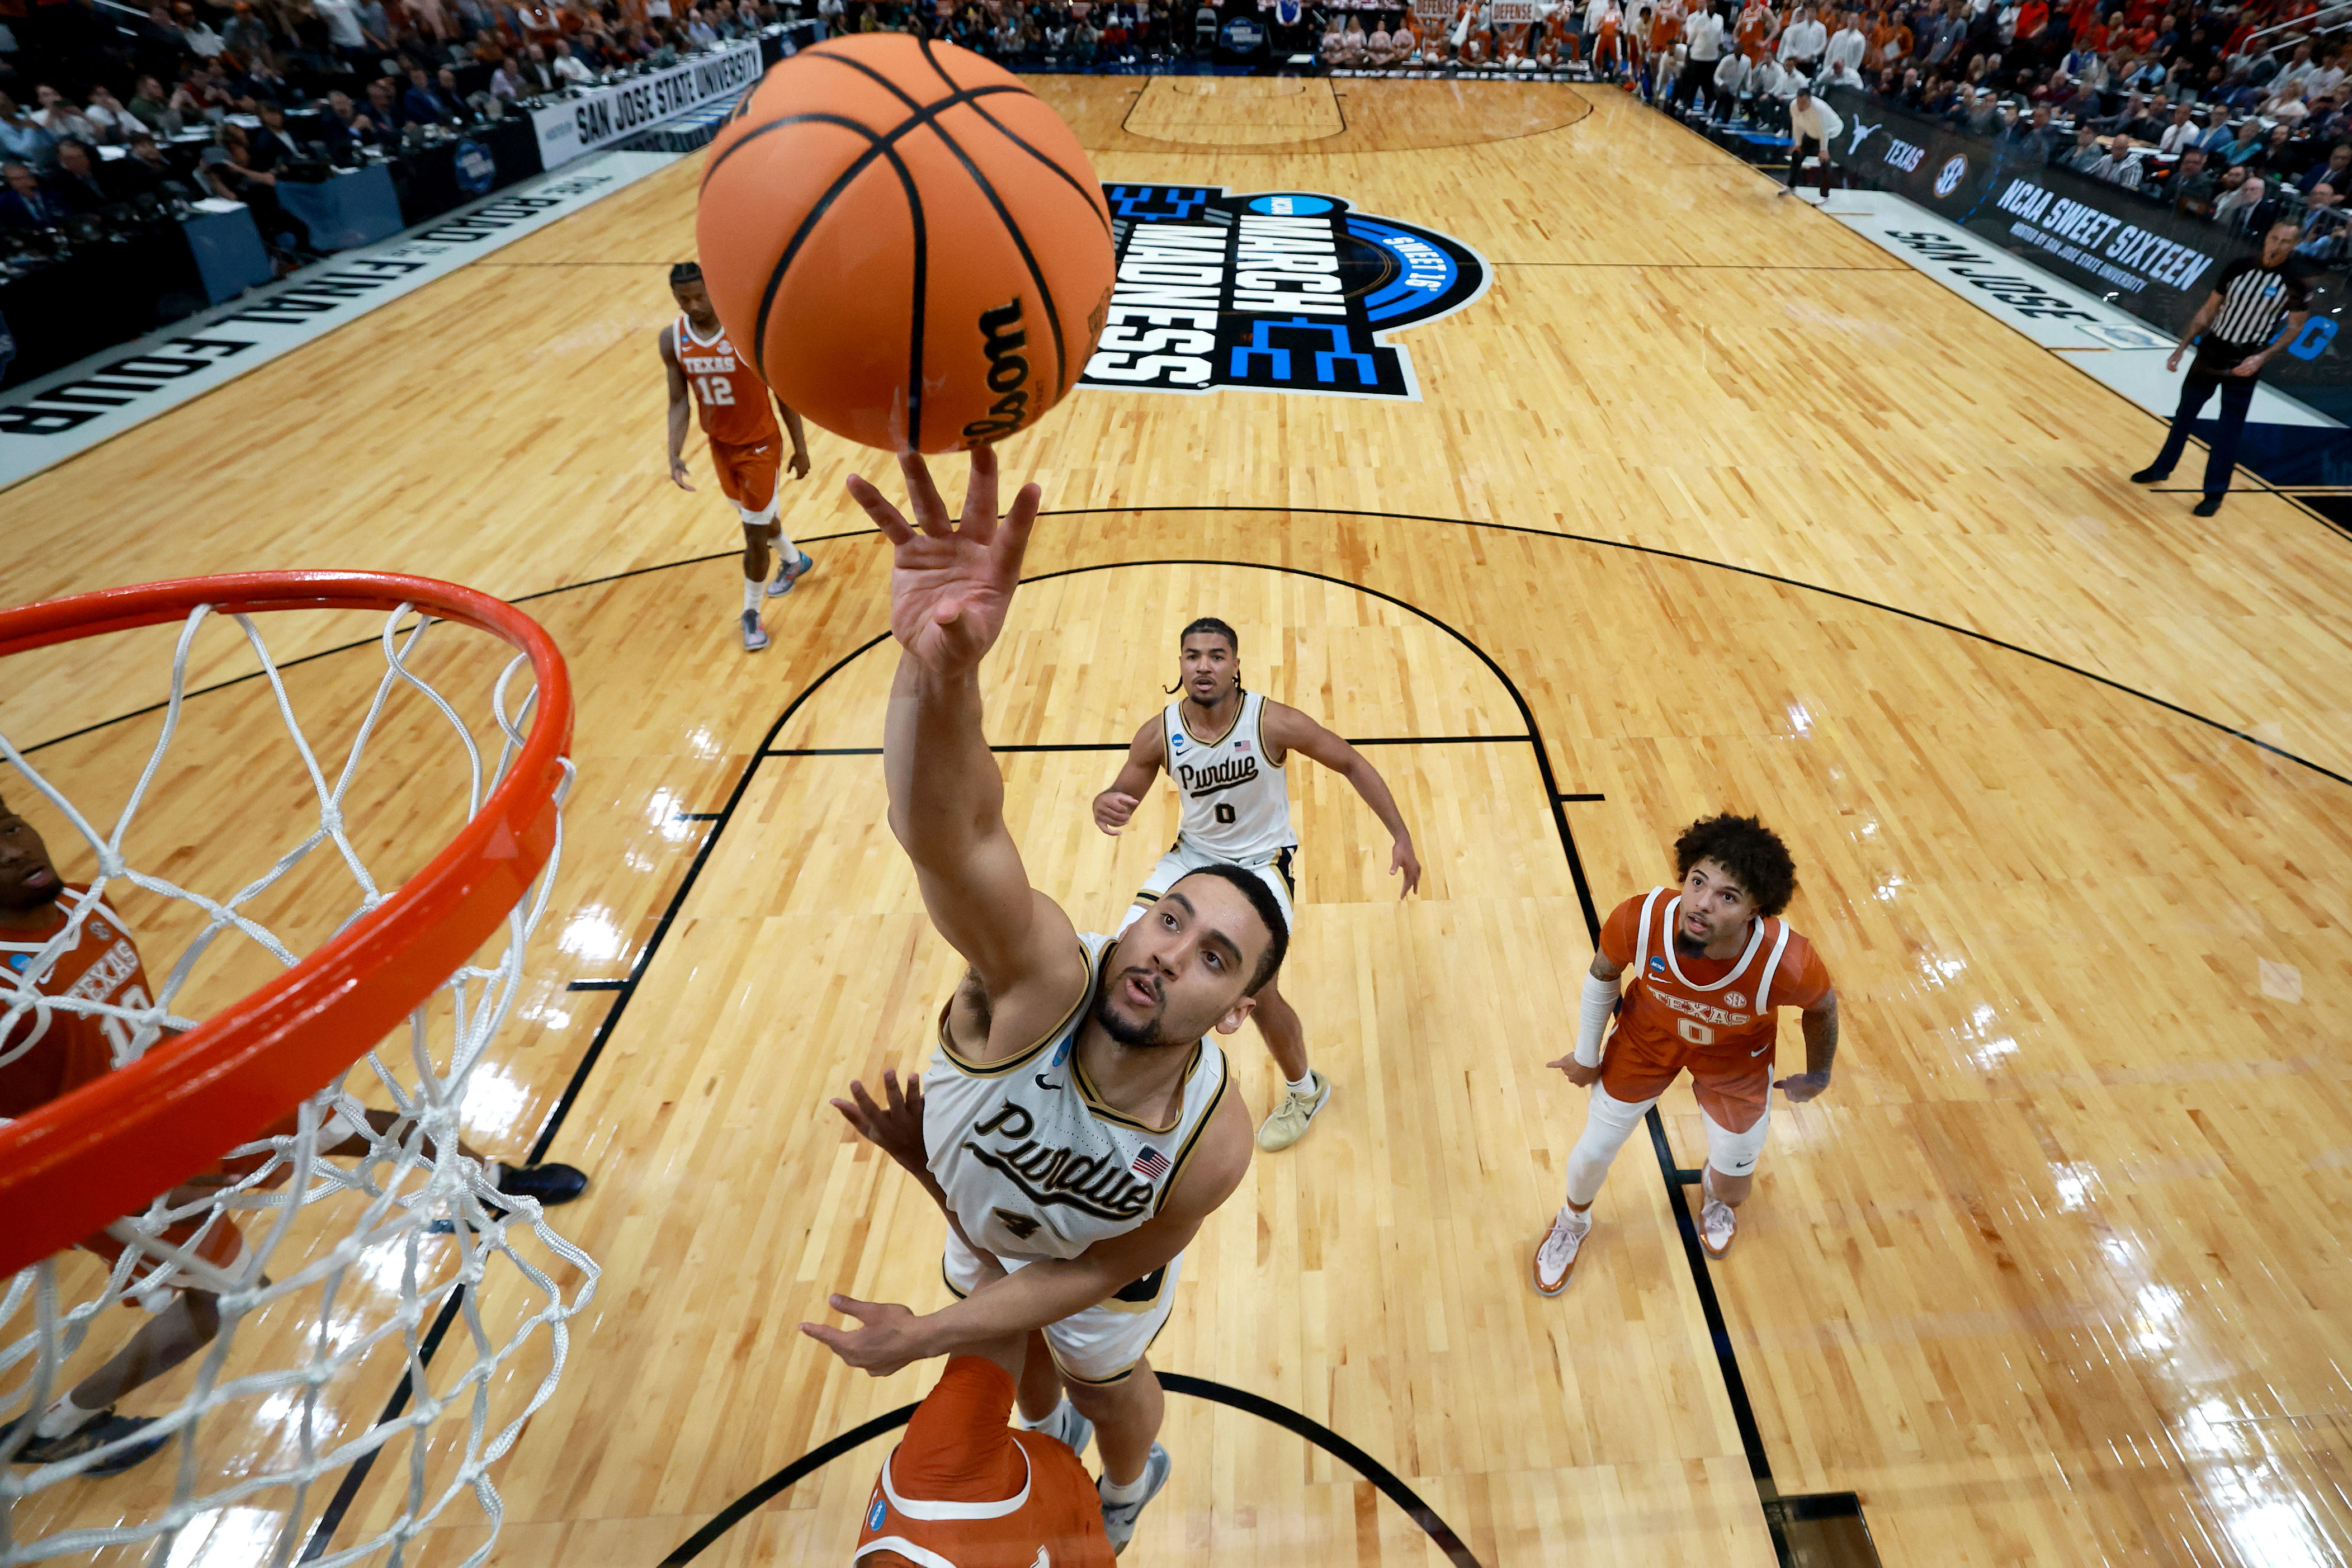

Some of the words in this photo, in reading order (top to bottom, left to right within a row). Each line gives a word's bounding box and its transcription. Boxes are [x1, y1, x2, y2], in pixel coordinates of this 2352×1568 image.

[575, 98, 612, 145] SAN
[616, 84, 655, 130] JOSE
[655, 70, 696, 114] STATE
[694, 48, 758, 99] UNIVERSITY
[1883, 138, 1926, 174] TEXAS
[412, 197, 563, 242] ROAD
[1996, 178, 2055, 223] NCAA
[2042, 197, 2123, 249] SWEET
[2105, 224, 2214, 291] SIXTEEN
[1232, 214, 1347, 315] MARCH
[1382, 237, 1447, 272] SWEET
[1884, 230, 1995, 265] SAN
[1948, 266, 2101, 323] JOSE
[206, 259, 428, 327] FINAL
[1404, 272, 1447, 287] 16
[1083, 224, 1228, 385] MADNESS
[0, 338, 259, 435] FOUR
[682, 356, 736, 374] TEXAS
[962, 294, 1029, 447] ilson
[697, 376, 736, 405] 12
[1178, 755, 1259, 798] Purdue
[1215, 802, 1236, 824] 0
[1646, 984, 1750, 1026] TEXAS
[1726, 992, 1745, 1007] SEC
[1678, 1018, 1715, 1045] 0
[962, 1097, 1154, 1221] Purdue
